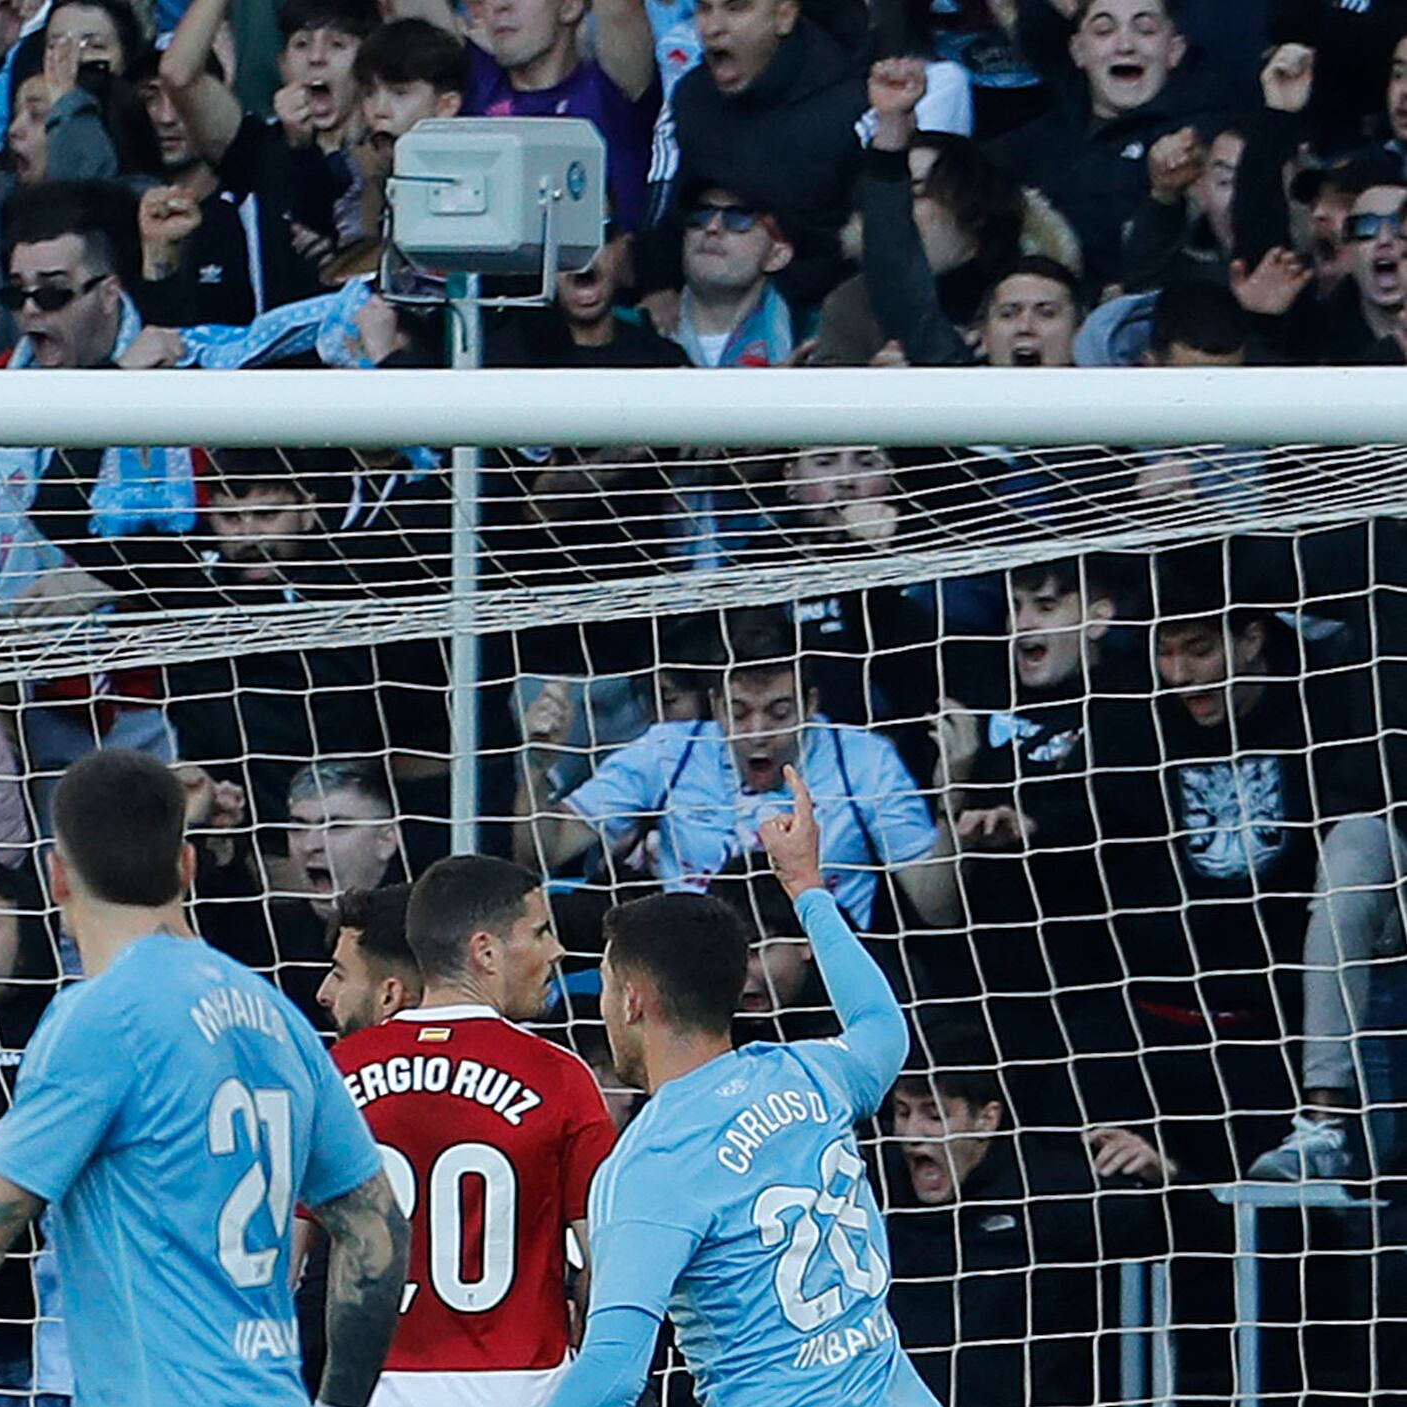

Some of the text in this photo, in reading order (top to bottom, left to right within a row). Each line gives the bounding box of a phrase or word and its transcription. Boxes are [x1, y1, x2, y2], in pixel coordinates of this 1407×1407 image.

[343, 1055, 542, 1127] ERGIO RUIZ
[717, 1090, 808, 1175] CARLOS
[208, 1076, 292, 1289] 21
